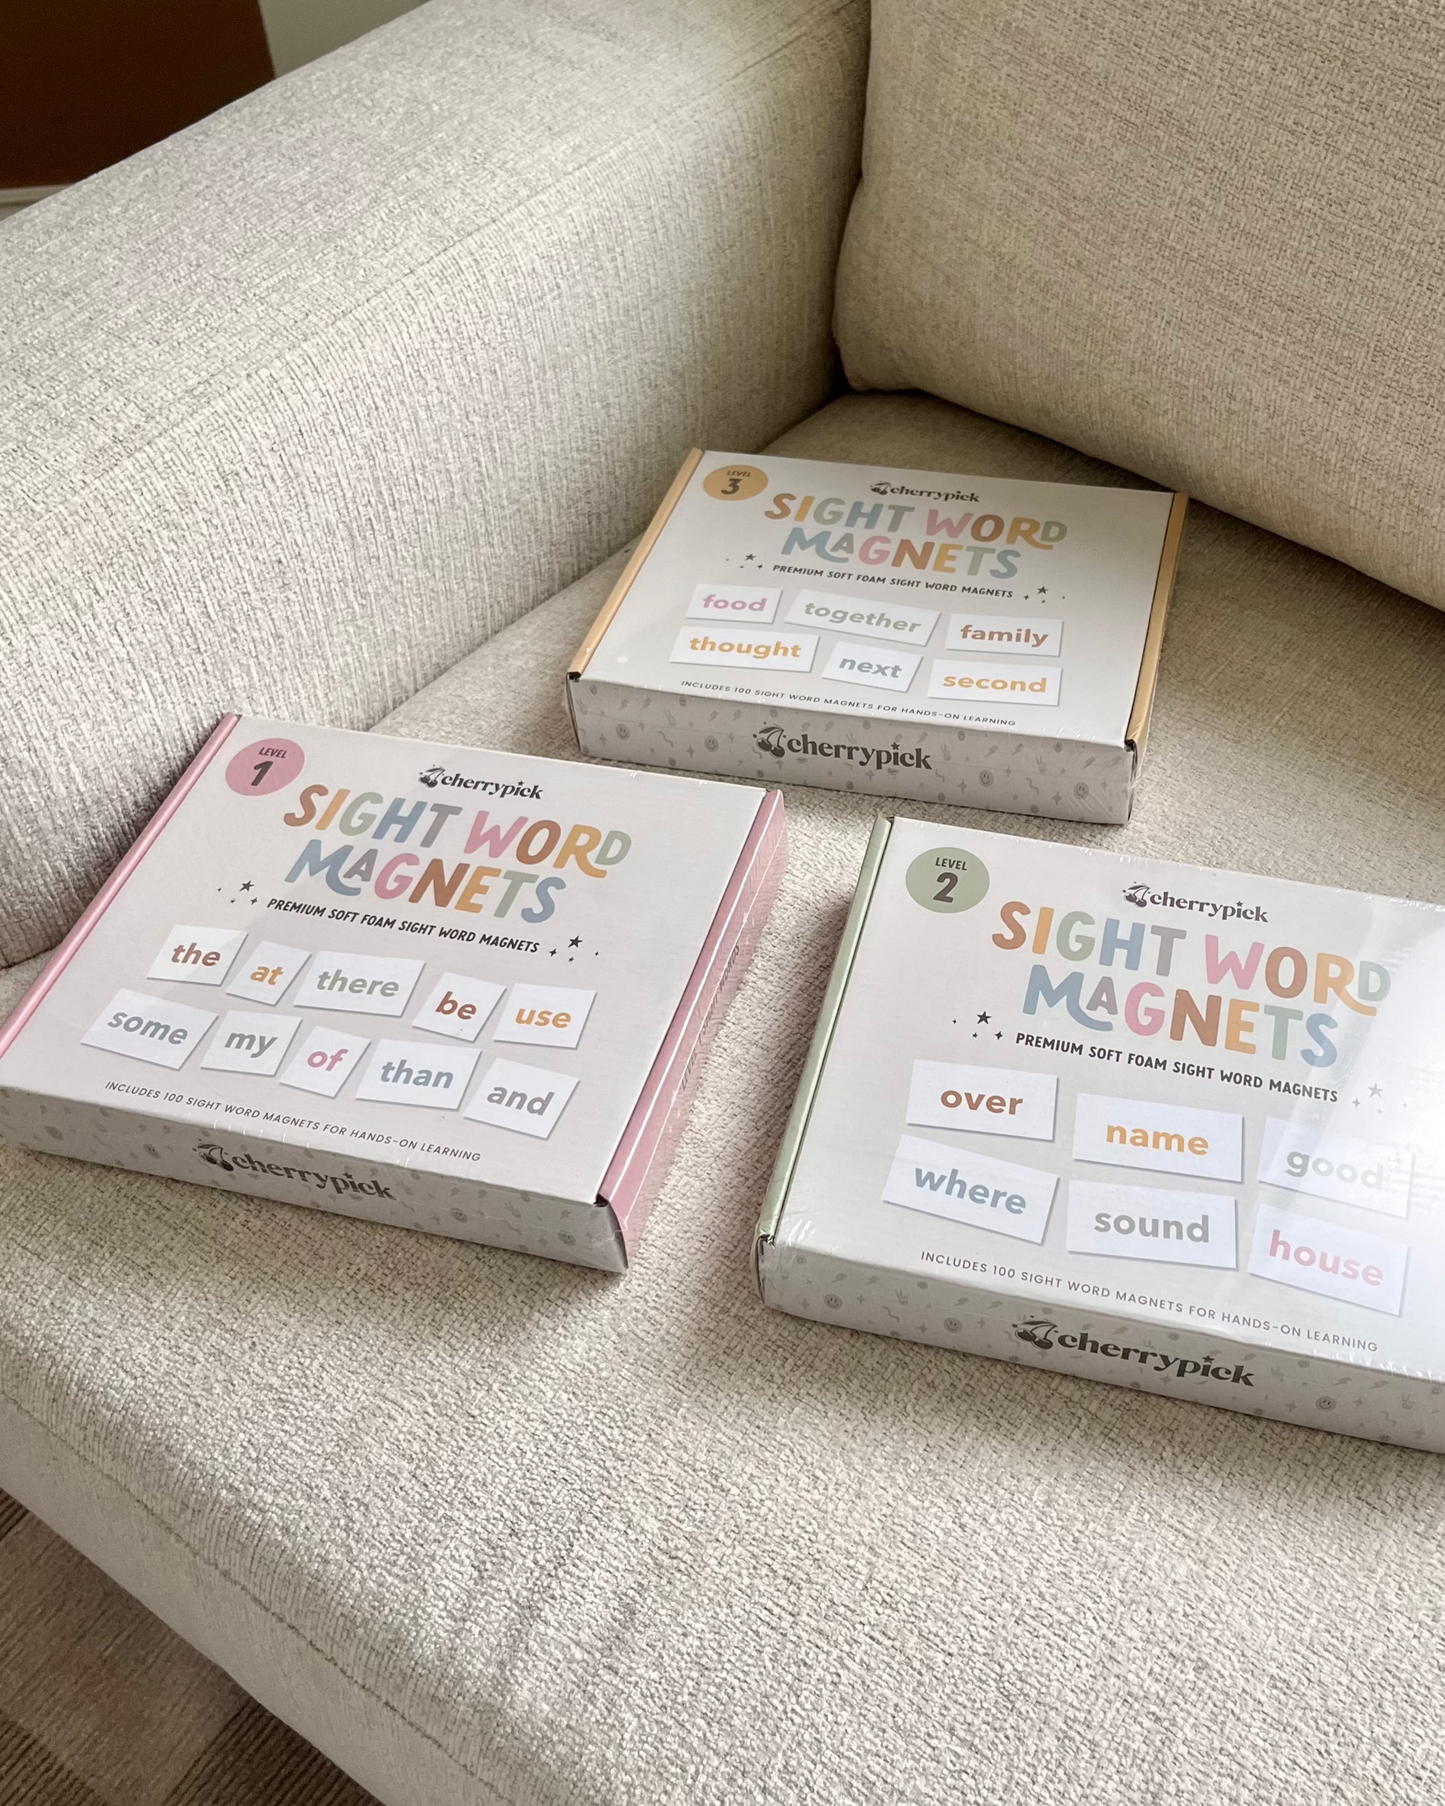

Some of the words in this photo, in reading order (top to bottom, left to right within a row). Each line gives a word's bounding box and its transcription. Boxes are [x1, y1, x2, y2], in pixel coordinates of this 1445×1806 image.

[720, 477, 743, 496] 3
[726, 470, 751, 478] LEVEL
[889, 485, 980, 503] cherrypick
[764, 493, 915, 533] SIGHT
[925, 509, 1067, 550] WORD
[781, 527, 1022, 579] MAGNETS
[772, 564, 824, 577] PREMIUM
[826, 570, 854, 581] SOFT
[855, 574, 887, 584] FOAM
[889, 578, 922, 588] SIGHT
[925, 581, 958, 592] WORD
[961, 585, 1014, 598] MAGNETS
[702, 594, 768, 612] food
[804, 601, 921, 632] together
[689, 636, 802, 660] thought
[960, 624, 1049, 648] family
[838, 658, 903, 679] next
[942, 675, 1048, 693] second
[681, 680, 731, 692] INCLUDES
[734, 686, 752, 695] 100
[754, 689, 786, 699] SIGHT
[789, 693, 821, 703] WORD
[823, 698, 874, 710] MAGNETS
[876, 704, 898, 712] FOR
[900, 707, 960, 720] HANDS-ON
[963, 715, 1016, 726] LEARNING
[258, 746, 288, 759] LEVEL
[787, 734, 932, 770] cherrypick
[250, 760, 274, 787] 1
[440, 773, 543, 800] cherrypick
[283, 784, 463, 848] SIGHT
[463, 810, 632, 878] WORD
[935, 856, 968, 871] LEVEL
[284, 839, 566, 924] MAGNETS
[933, 872, 958, 903] 2
[1150, 892, 1268, 922] cherrypick
[266, 898, 327, 918] PREMIUM
[327, 908, 360, 923] SOFT
[360, 914, 397, 929] FOAM
[397, 920, 437, 936] SIGHT
[438, 926, 477, 942] WORD
[478, 933, 540, 953] MAGNETS
[171, 942, 221, 967] the
[992, 901, 1187, 976] SIGHT
[1205, 934, 1392, 1016] WORD
[249, 966, 284, 986] at
[317, 969, 399, 997] there
[435, 991, 476, 1019] be
[515, 1008, 572, 1029] use
[1022, 964, 1339, 1068] MAGNETS
[107, 1013, 187, 1044] some
[224, 1032, 279, 1059] my
[306, 1048, 350, 1072] of
[381, 1059, 453, 1088] than
[1015, 1032, 1084, 1056] PREMIUM
[1088, 1046, 1123, 1063] SOFT
[1127, 1052, 1168, 1071] FOAM
[1172, 1061, 1215, 1080] SIGHT
[1220, 1069, 1263, 1088] WORD
[1268, 1078, 1338, 1103] MAGNETS
[487, 1087, 554, 1115] and
[940, 1090, 1024, 1116] over
[104, 1081, 162, 1099] INCLUDES
[163, 1092, 184, 1103] 100
[185, 1096, 222, 1111] SIGHT
[224, 1104, 261, 1118] WORD
[262, 1111, 321, 1131] MAGNETS
[322, 1123, 348, 1136] FOR
[349, 1129, 419, 1150] HANDS-ON
[420, 1142, 481, 1162] LEARNING
[1107, 1125, 1208, 1155] name
[232, 1153, 396, 1199] cherrypick
[1285, 1148, 1384, 1191] good
[914, 1167, 1027, 1215] where
[1094, 1213, 1209, 1243] sound
[1268, 1229, 1383, 1286] house
[920, 1250, 988, 1273] INCLUDES
[993, 1264, 1016, 1279] 100
[1020, 1271, 1063, 1288] SIGHT
[1067, 1280, 1111, 1298] WORD
[1115, 1290, 1183, 1313] MAGNETS
[1188, 1305, 1216, 1320] FOR
[1221, 1311, 1301, 1337] HANDS-ON
[1306, 1329, 1378, 1352] LEARNING
[1057, 1329, 1255, 1387] cherrypick
